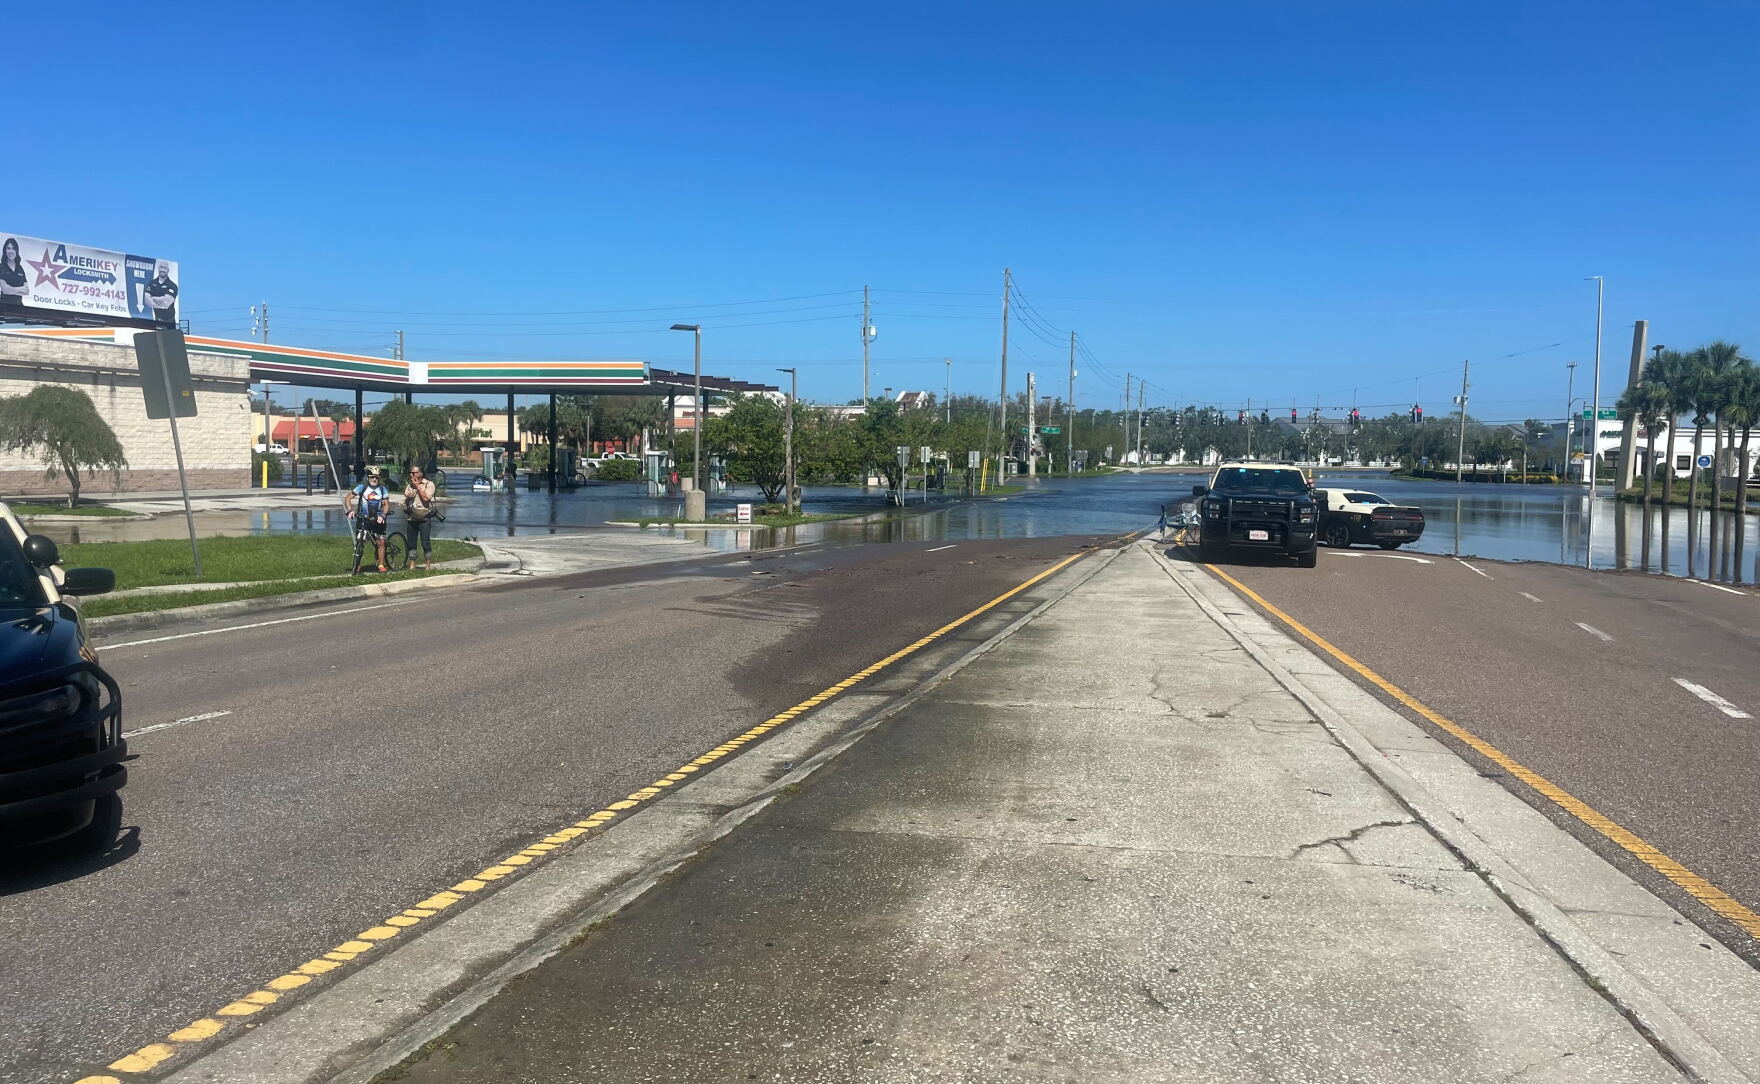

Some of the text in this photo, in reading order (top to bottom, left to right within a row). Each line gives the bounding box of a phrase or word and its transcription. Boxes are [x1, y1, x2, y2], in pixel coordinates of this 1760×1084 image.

[73, 269, 109, 279] LOCKSMITH
[133, 269, 146, 279] HERE
[61, 283, 126, 300] 727-992-4143
[33, 294, 53, 304] Door
[54, 298, 76, 307] Locks
[96, 302, 109, 311] Key
[111, 304, 127, 312] Fobs
